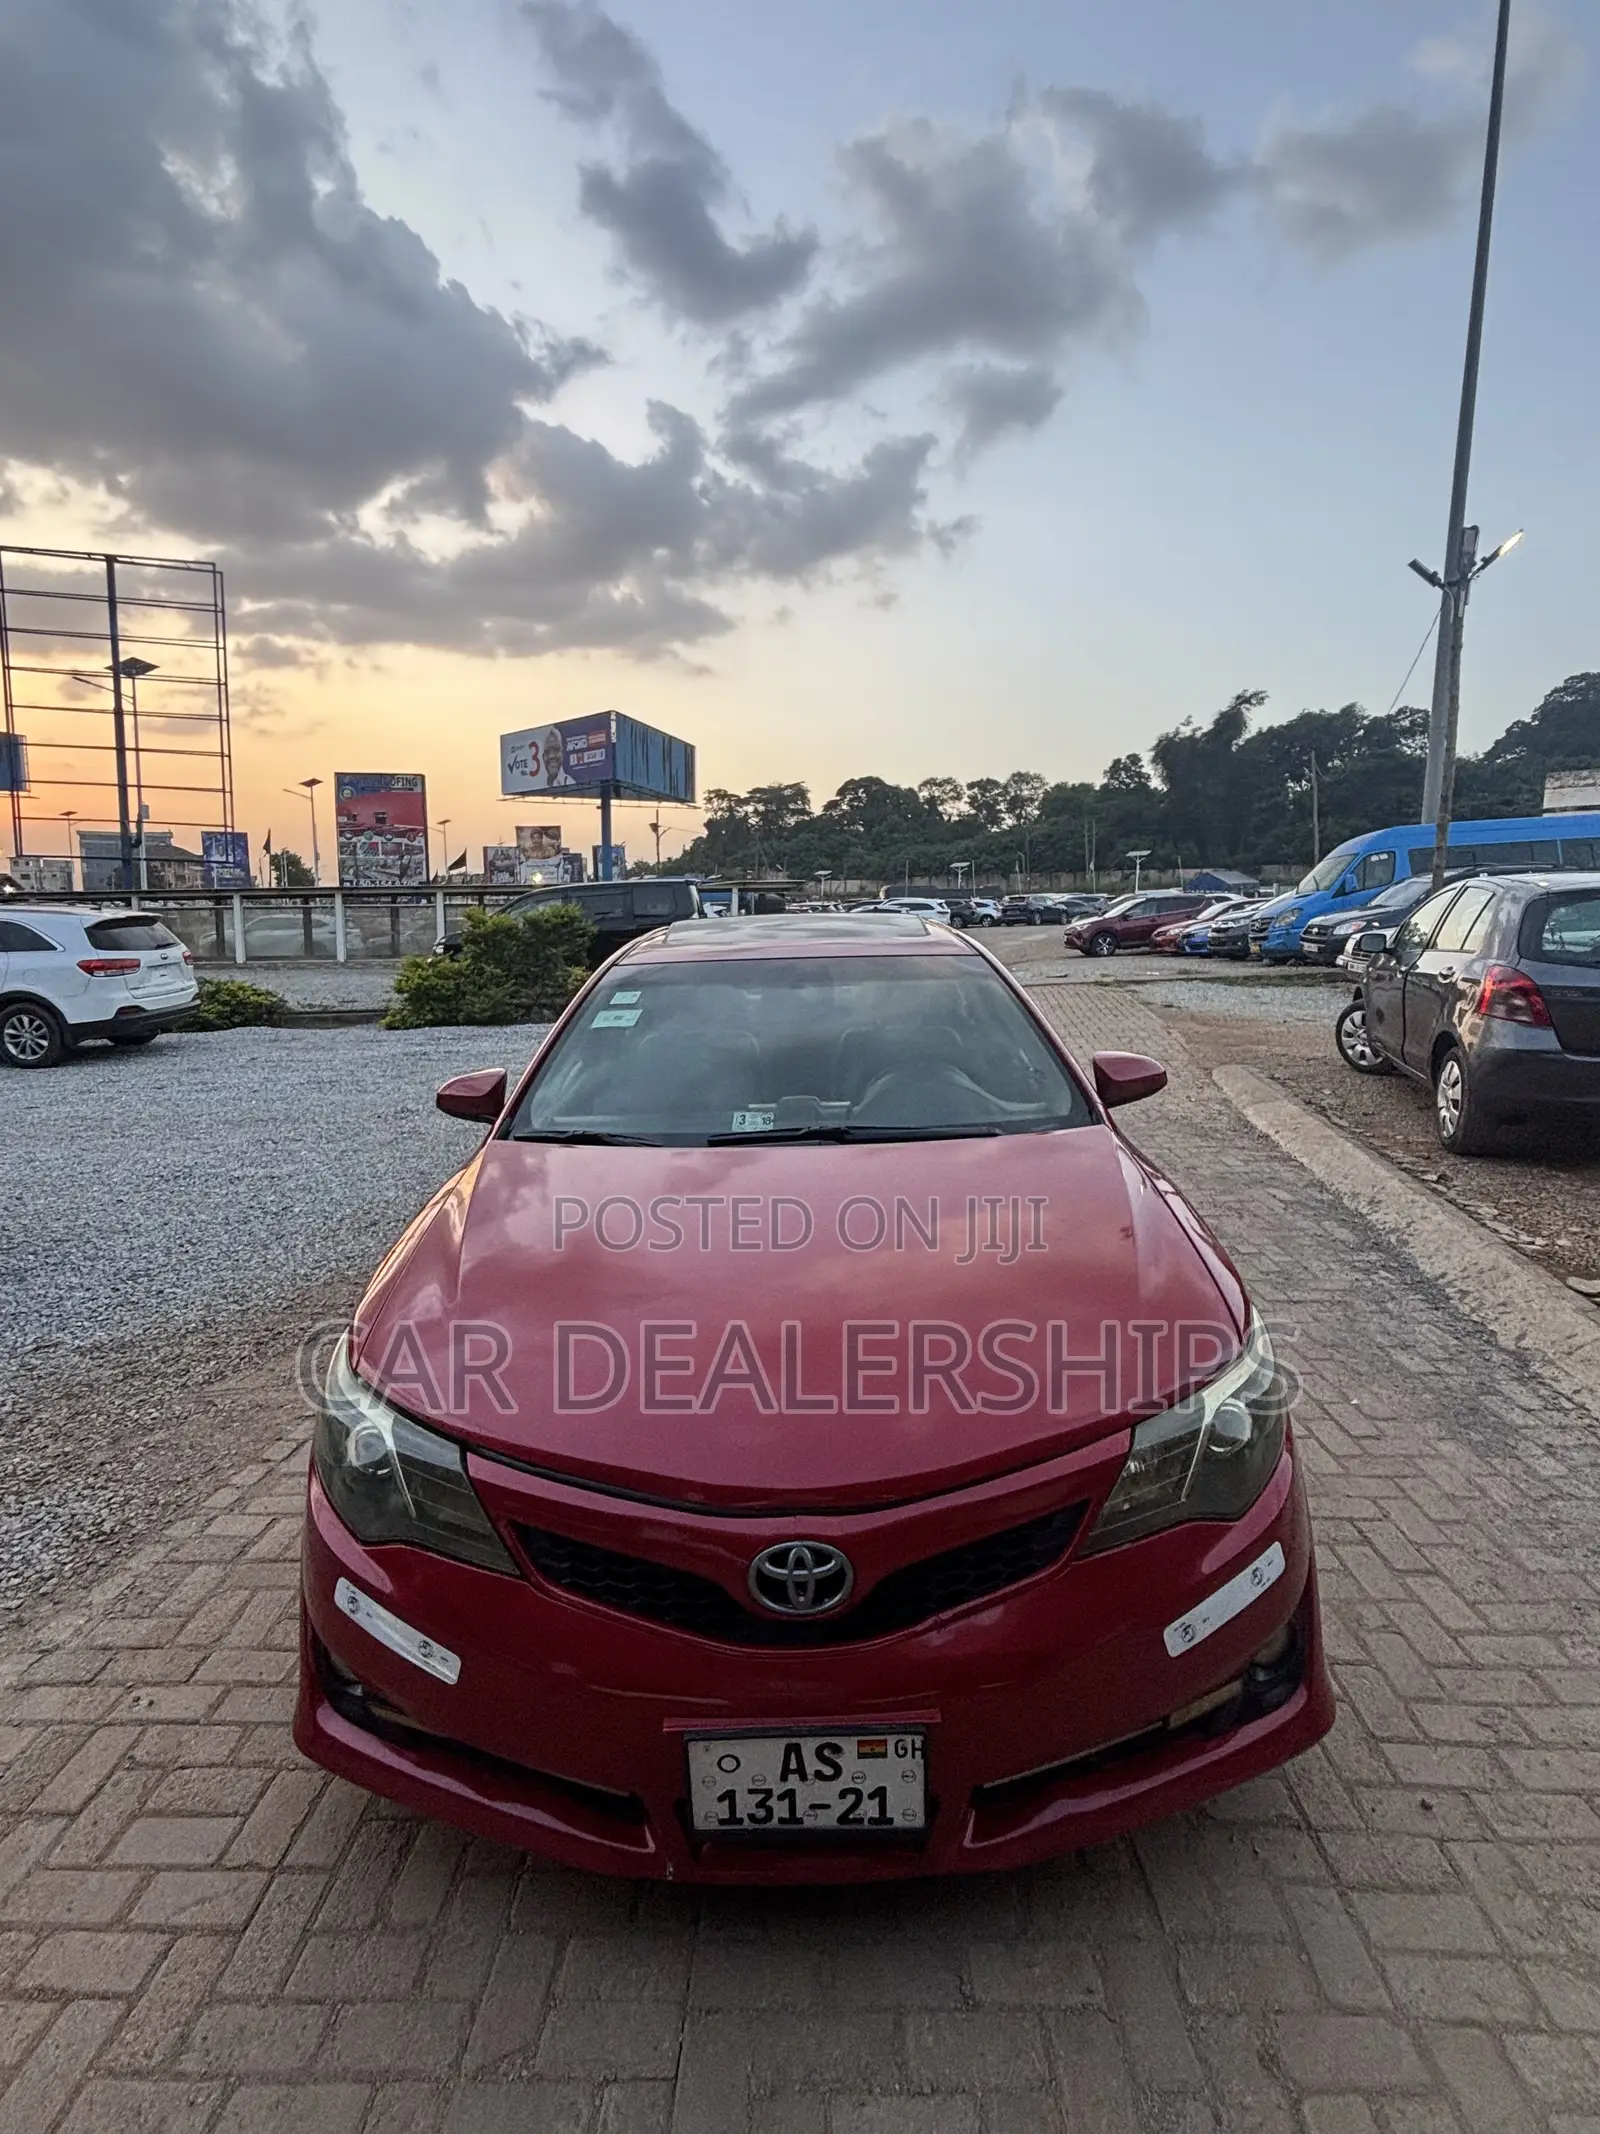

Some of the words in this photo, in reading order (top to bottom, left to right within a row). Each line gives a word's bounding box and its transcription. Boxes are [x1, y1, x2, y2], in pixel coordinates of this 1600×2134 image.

[507, 755, 529, 775] VOTE
[529, 740, 541, 777] 3
[738, 1113, 747, 1126] 3
[780, 1742, 844, 1782] AS
[894, 1738, 925, 1760] GH
[717, 1786, 895, 1826] 131-21
